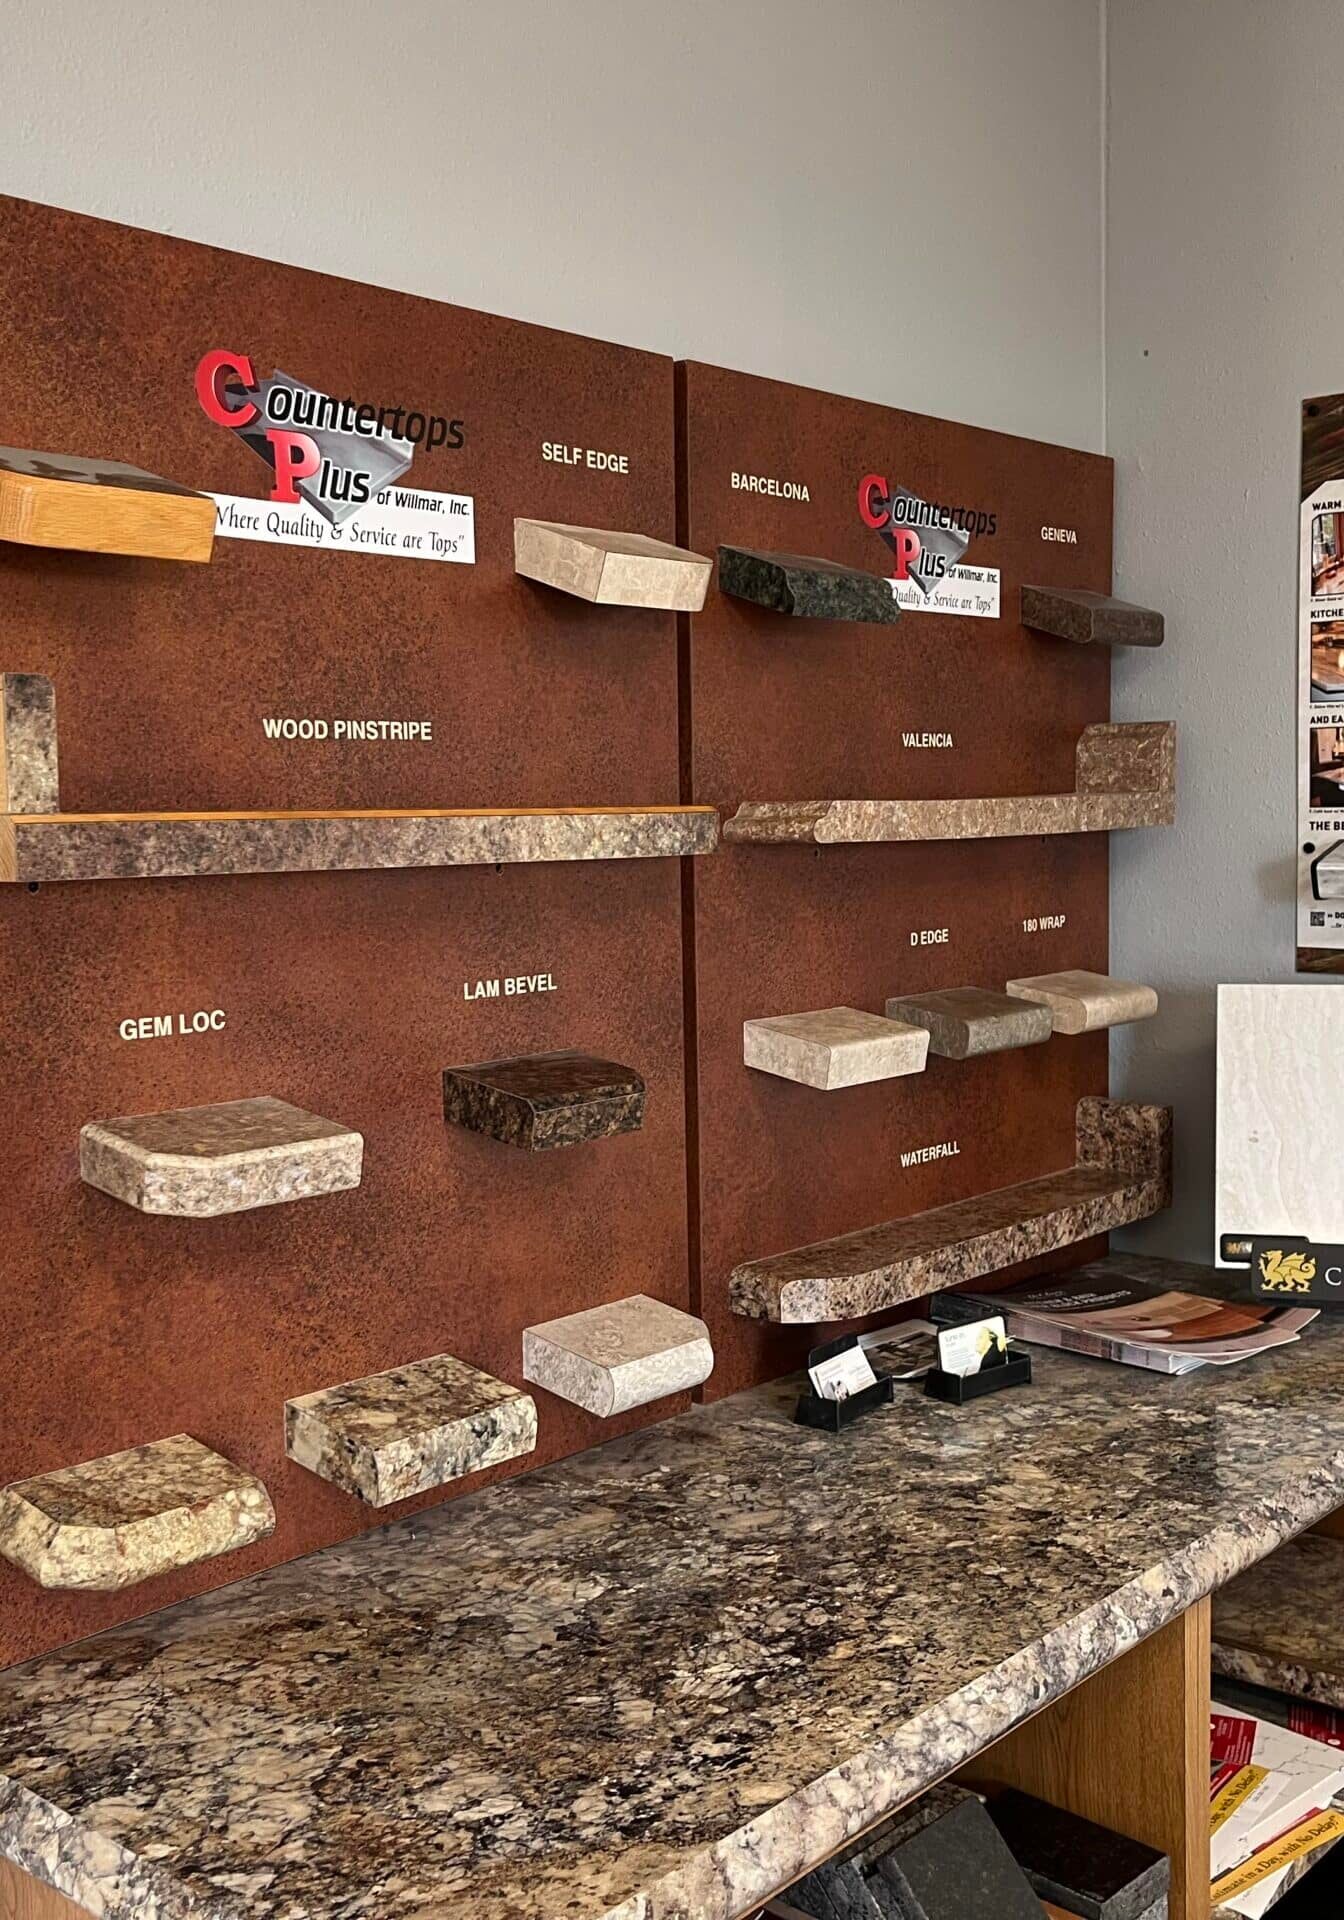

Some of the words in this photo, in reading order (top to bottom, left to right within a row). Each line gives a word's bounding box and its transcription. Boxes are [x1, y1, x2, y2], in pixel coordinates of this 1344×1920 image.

[194, 349, 466, 453] Countertops
[265, 428, 371, 505] Plus
[542, 441, 582, 465] SELF
[586, 450, 629, 474] EDGE
[731, 472, 810, 502] BARCELONA
[376, 490, 392, 505] of
[395, 491, 445, 514] Willmar,
[449, 499, 471, 516] Inc.
[858, 474, 996, 539] Countertops
[1312, 500, 1341, 511] WARM
[266, 511, 324, 543] Quality
[330, 521, 344, 540] &
[349, 522, 397, 546] Service
[402, 534, 423, 549] are
[1041, 526, 1077, 544] GENEVA
[892, 528, 946, 580] Plus
[948, 567, 957, 578] of
[957, 567, 985, 583] Willmar,
[986, 571, 998, 583] Inc.
[933, 591, 959, 609] Service
[961, 599, 972, 610] are
[262, 718, 329, 740] WOOD
[333, 720, 433, 741] PINSTRIPE
[1310, 715, 1329, 723] AND
[902, 732, 953, 748] VALENCIA
[1309, 821, 1330, 831] THE
[1022, 919, 1037, 933] 180
[1039, 914, 1066, 931] WRAP
[910, 932, 918, 946] D
[920, 928, 949, 945] EDGE
[463, 979, 500, 1000] LAM
[503, 973, 558, 996] BEVEL
[119, 1017, 173, 1041] GEM
[178, 1009, 226, 1034] LOC
[900, 1140, 961, 1168] WATERFALL
[1279, 1842, 1300, 1857] with
[1298, 1834, 1314, 1847] No
